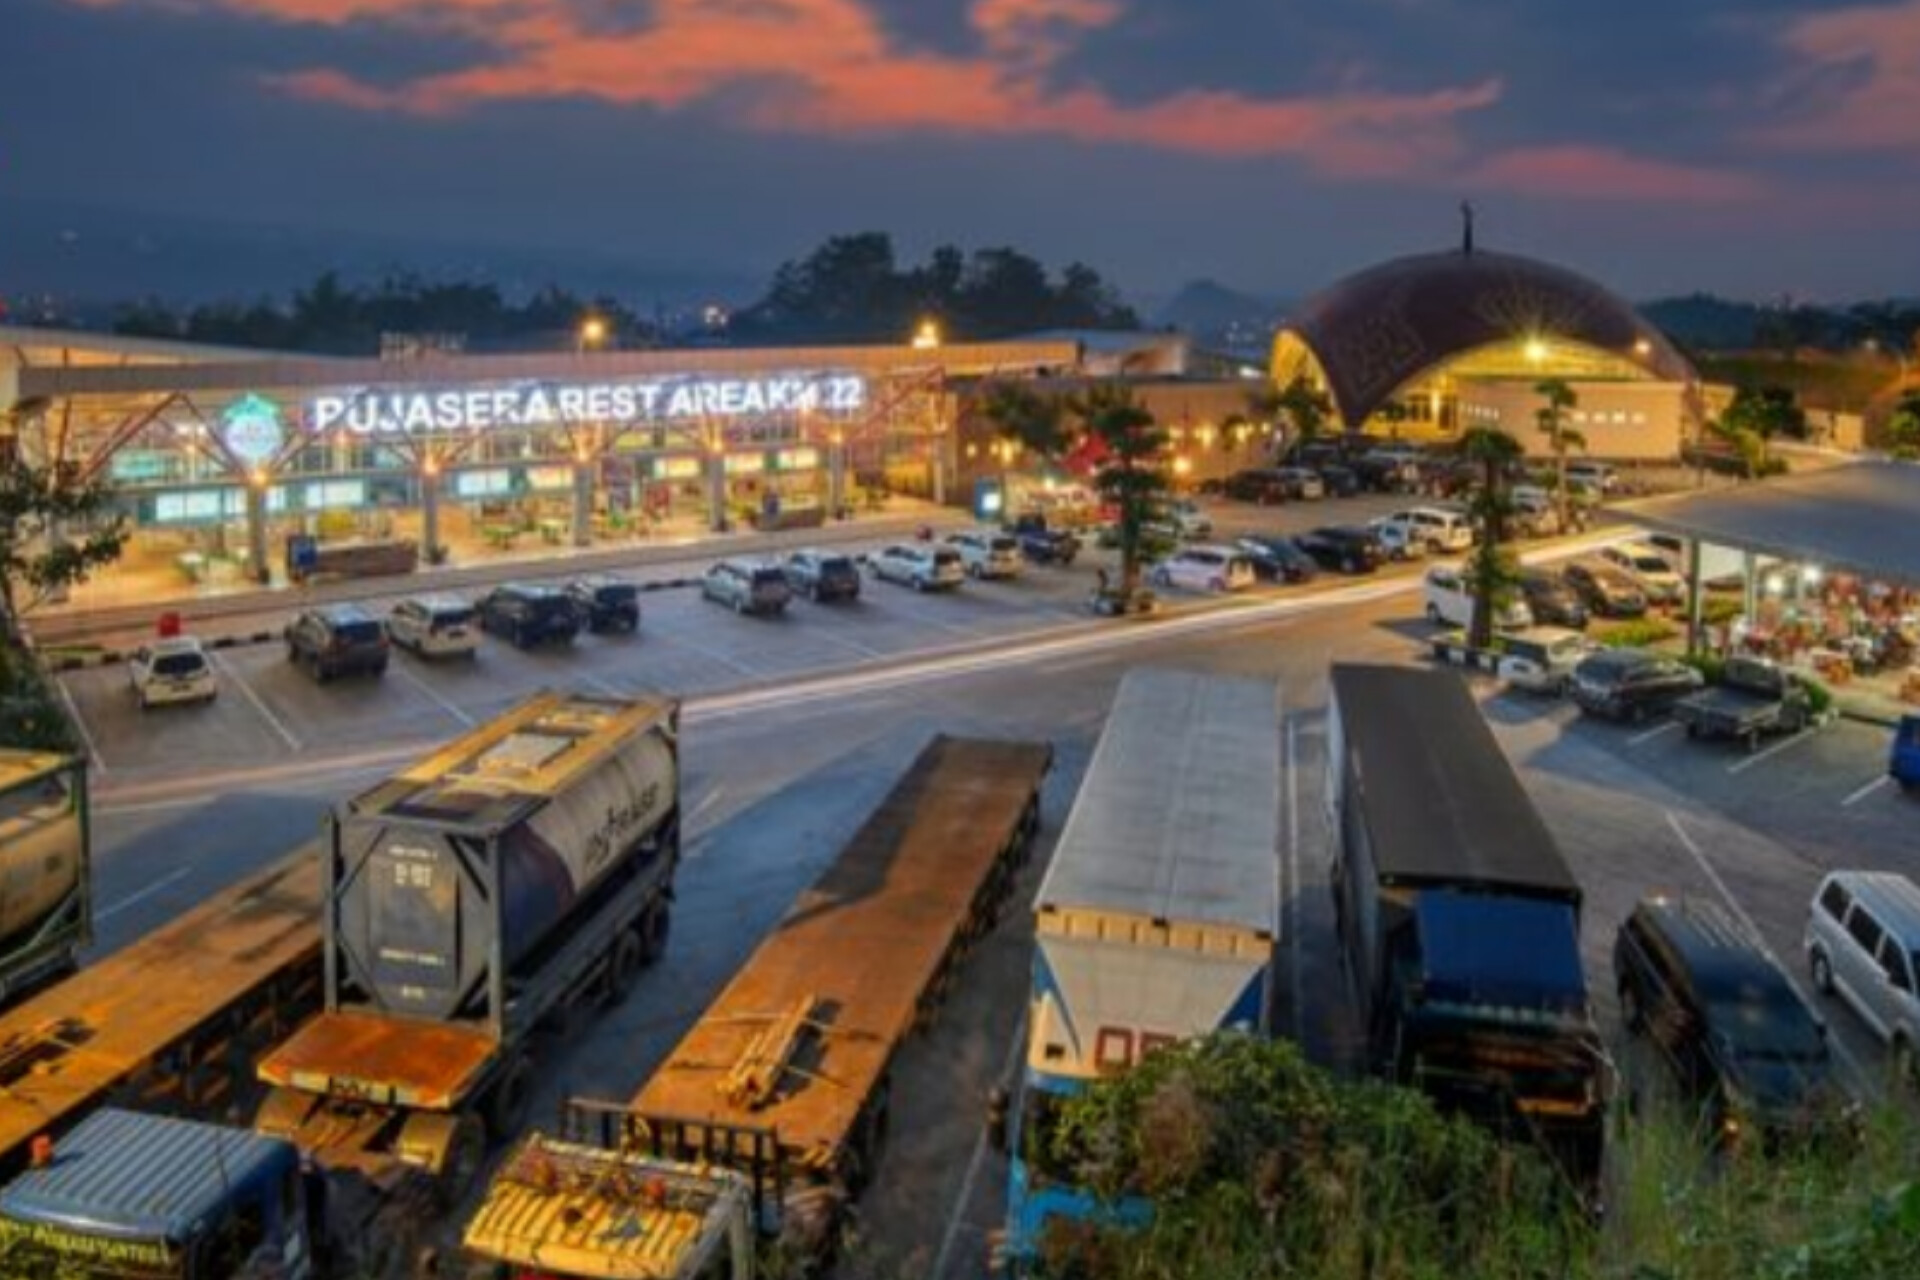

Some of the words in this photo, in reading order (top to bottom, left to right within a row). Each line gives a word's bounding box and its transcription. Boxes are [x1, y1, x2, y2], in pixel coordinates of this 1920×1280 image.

[314, 388, 552, 433] PUJASERA
[558, 383, 662, 421] REST
[667, 378, 767, 416] AREA
